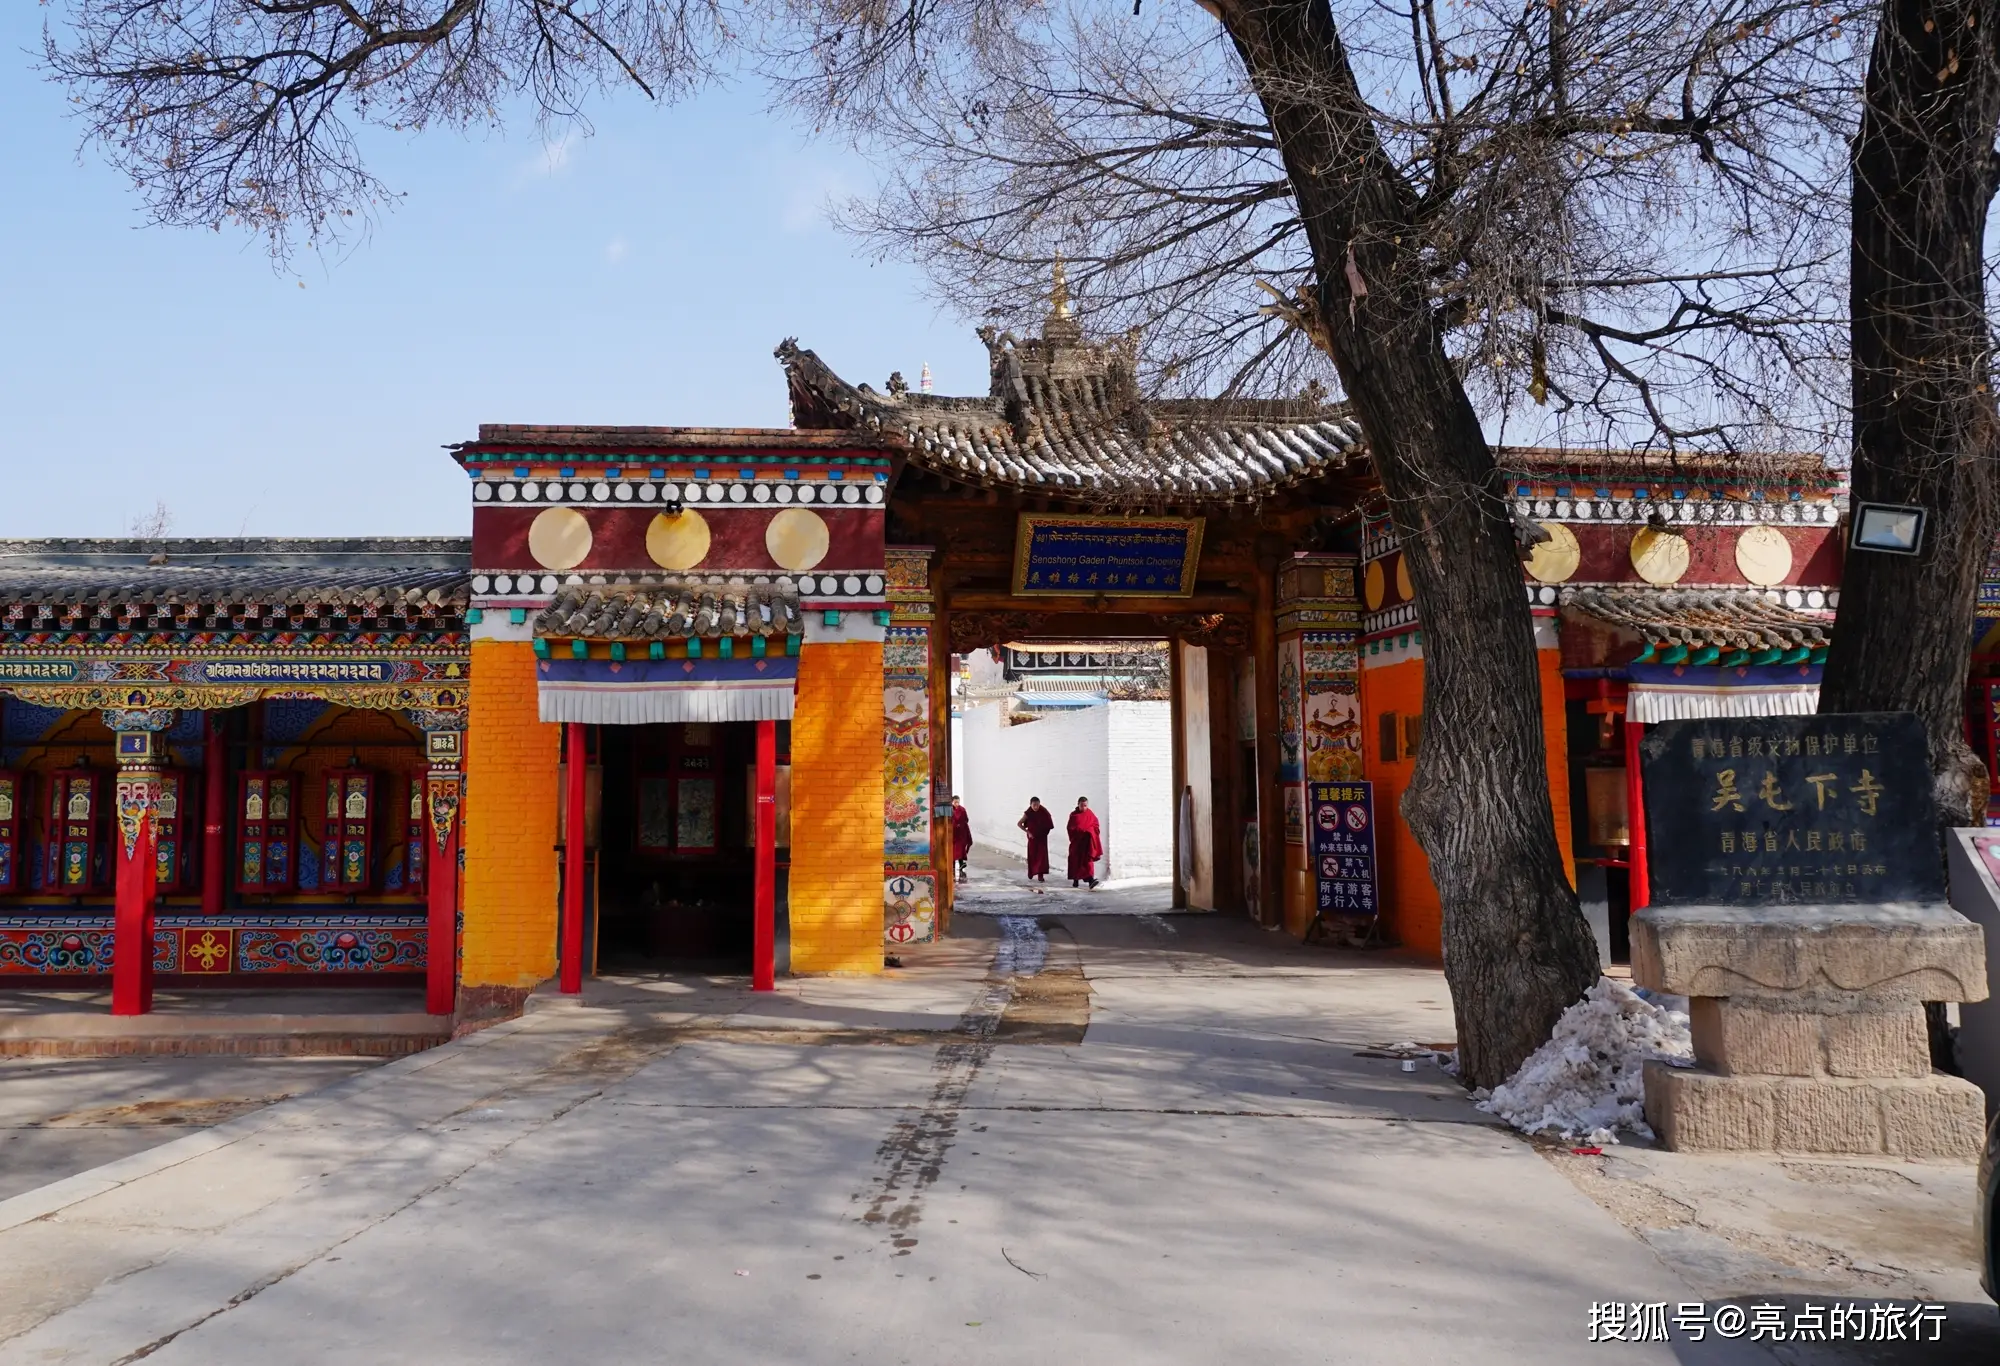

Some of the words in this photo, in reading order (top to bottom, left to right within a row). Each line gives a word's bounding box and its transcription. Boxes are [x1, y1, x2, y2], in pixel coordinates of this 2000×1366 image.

[1079, 556, 1106, 565] Gaden
[1107, 556, 1144, 565] Phuntsok
[1691, 734, 1880, 757] 青海省级文物保护单位
[1318, 788, 1365, 801] 温馨提示
[1711, 768, 1884, 815] 吴屯下寺
[1333, 833, 1354, 842] 禁止
[1721, 830, 1867, 852] 青海省人民政府
[1320, 843, 1368, 854] 外来车辆入寺
[1345, 858, 1364, 867] 禁飞
[1341, 868, 1370, 879] 无人机
[1320, 882, 1372, 896] 所有游客
[1321, 895, 1372, 910] 步行入寺
